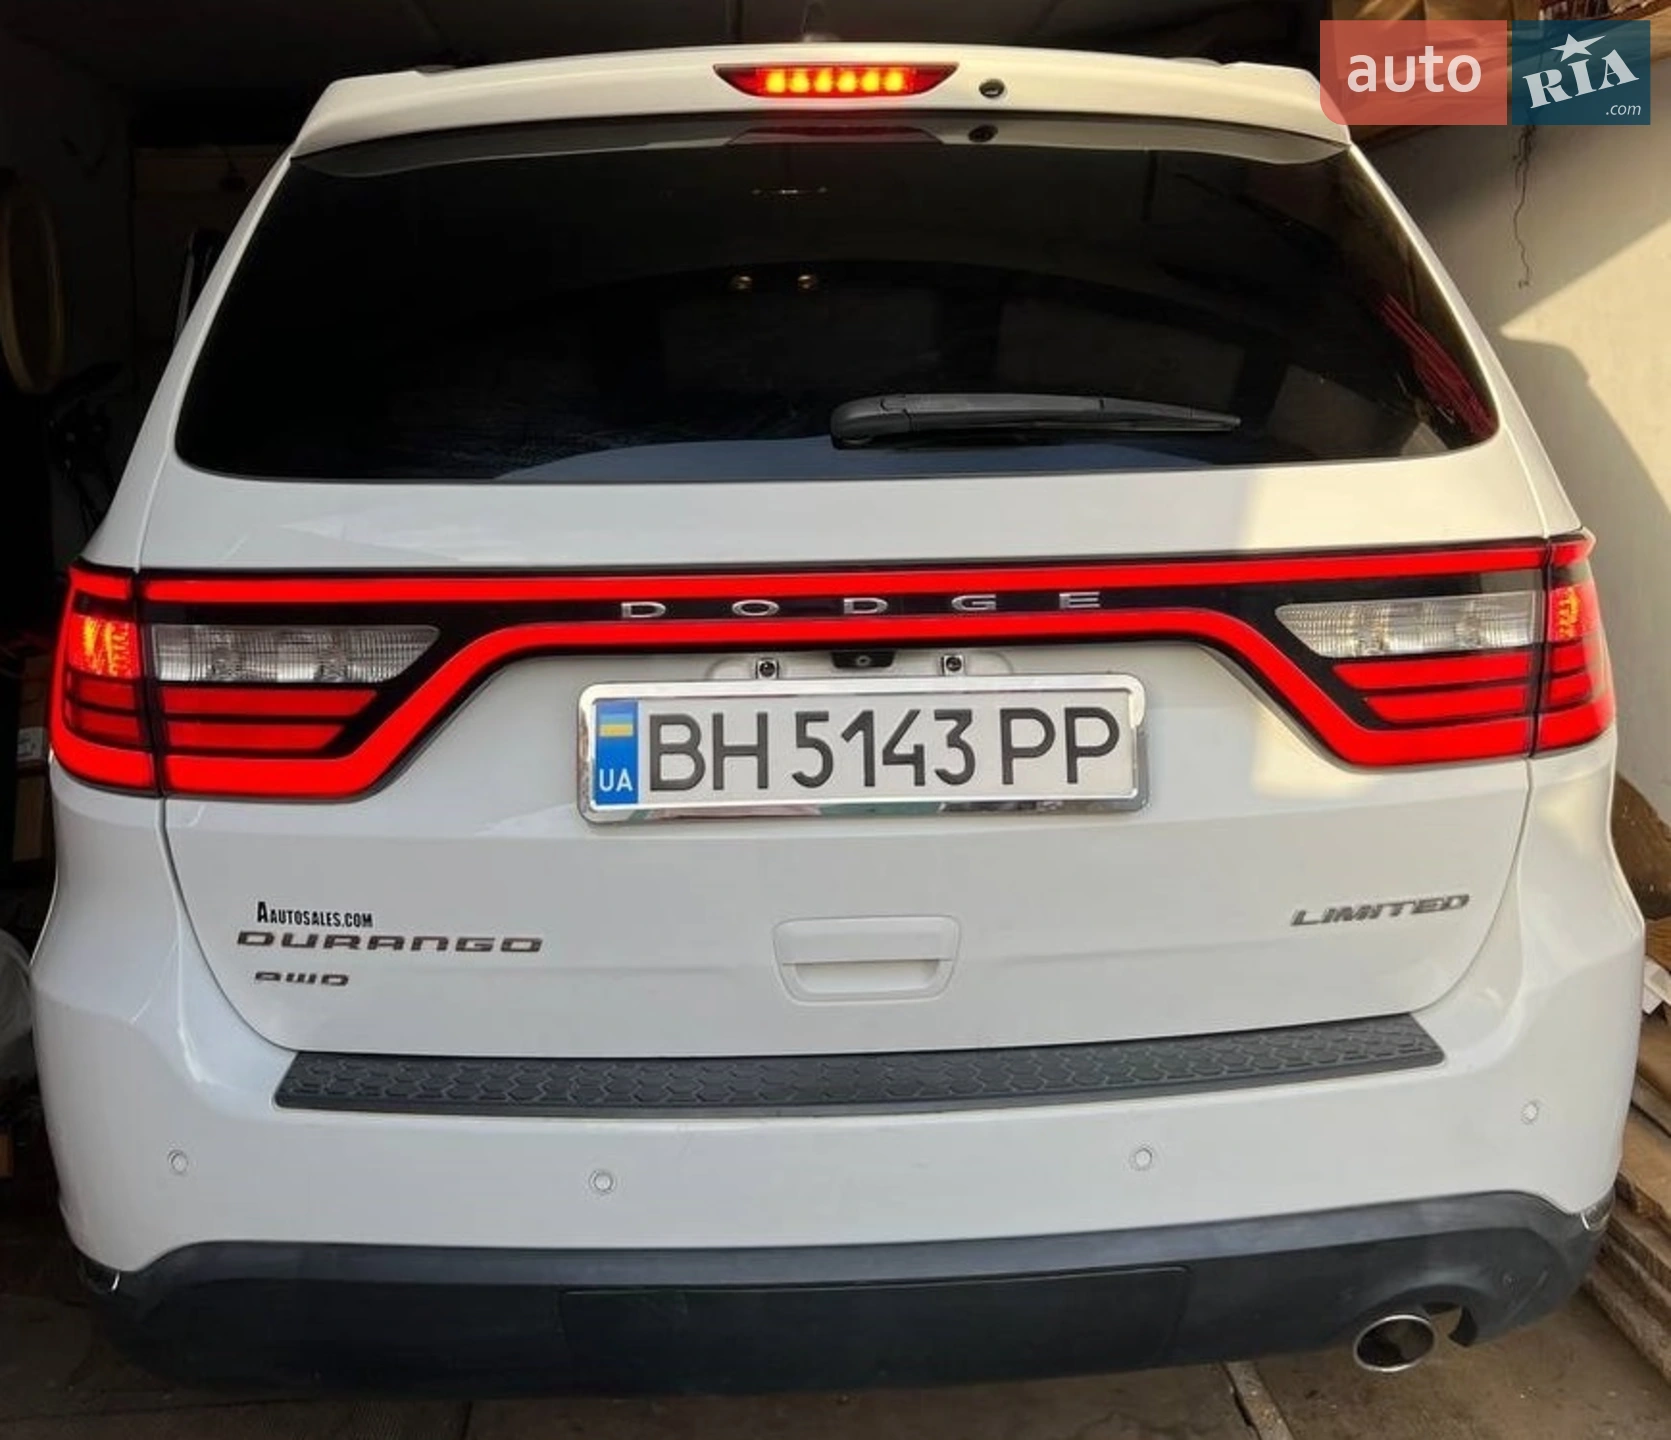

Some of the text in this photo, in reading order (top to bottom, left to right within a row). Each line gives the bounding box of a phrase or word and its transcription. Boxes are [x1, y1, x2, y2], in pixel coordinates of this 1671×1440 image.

[621, 591, 1100, 618] DODGE
[649, 707, 1120, 791] BH 5143 PP
[599, 768, 634, 791] UA
[1290, 894, 1470, 926] LIMITED
[237, 930, 543, 953] DURANGO
[255, 971, 349, 987] AWD
